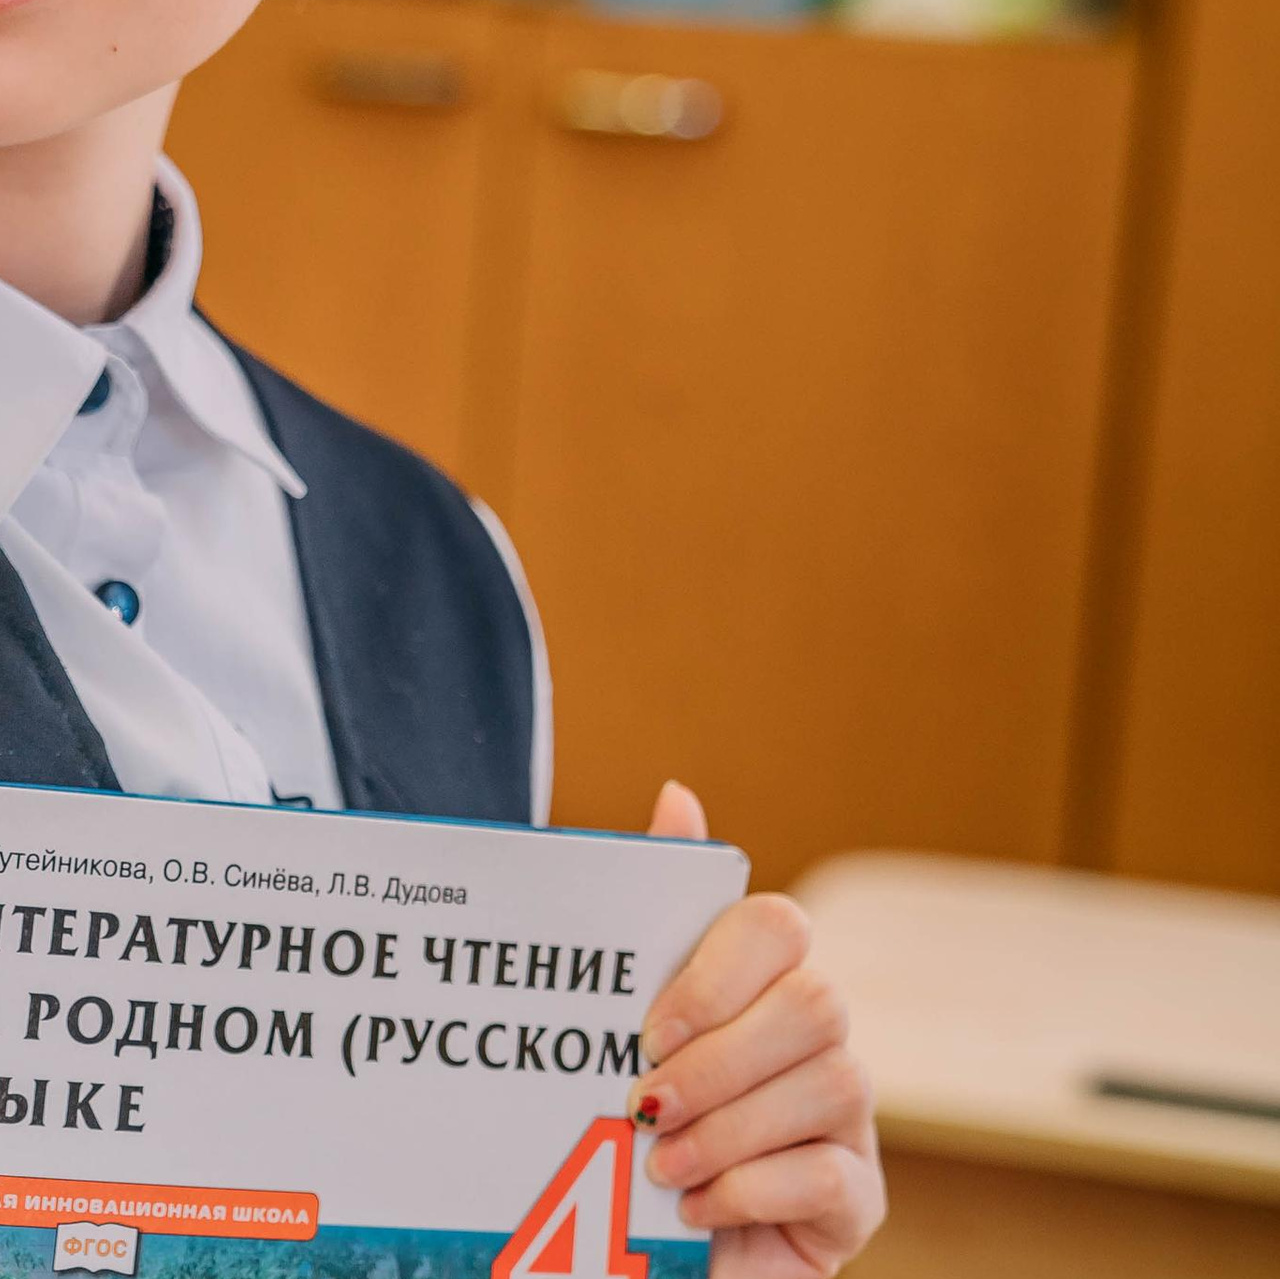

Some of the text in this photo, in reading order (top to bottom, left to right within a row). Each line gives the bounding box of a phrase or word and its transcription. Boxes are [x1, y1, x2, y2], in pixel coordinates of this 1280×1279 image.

[162, 858, 215, 886] О.В.
[223, 863, 321, 898] Синёва,
[326, 871, 376, 898] Л.В.
[381, 876, 468, 906] Дудова
[423, 936, 636, 995] ЧТЕНИЕ
[24, 991, 315, 1059] РОДНОМ
[341, 1013, 658, 1079] (РУССКОМ
[23, 1194, 227, 1222] ИННОВАЦИОННАЯ
[231, 1205, 310, 1225] ШКОЛА
[62, 1235, 128, 1259] ФГОС
